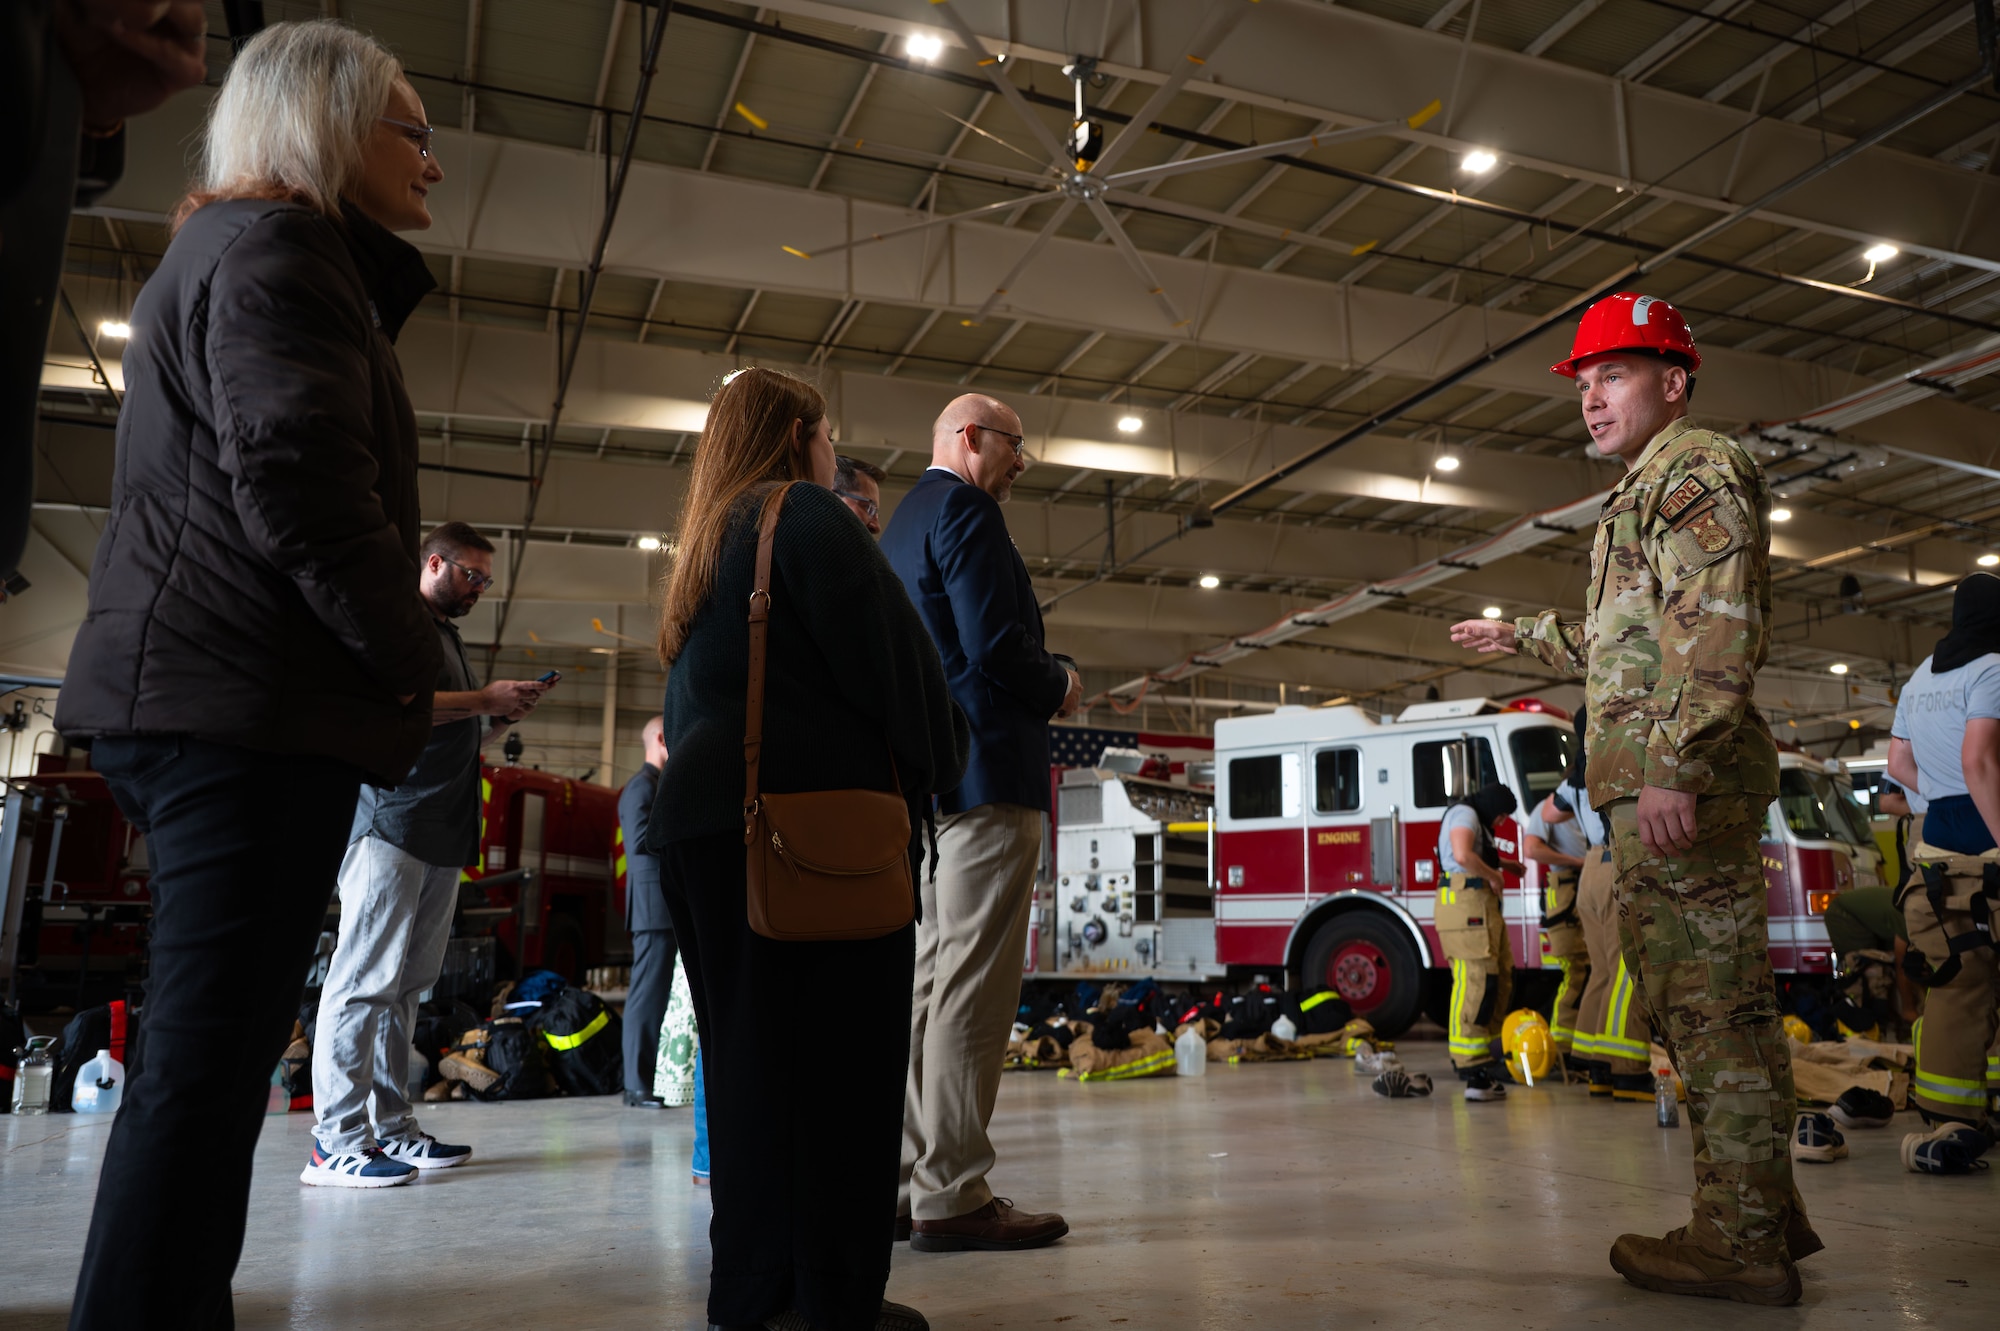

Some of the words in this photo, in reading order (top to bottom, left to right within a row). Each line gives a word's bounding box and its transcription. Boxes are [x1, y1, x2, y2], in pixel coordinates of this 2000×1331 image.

[1661, 480, 1702, 518] FIRE
[1915, 688, 1964, 713] FORCE
[1318, 831, 1361, 845] ENGINE
[1494, 837, 1515, 854] TES
[1762, 856, 1783, 871] TES
